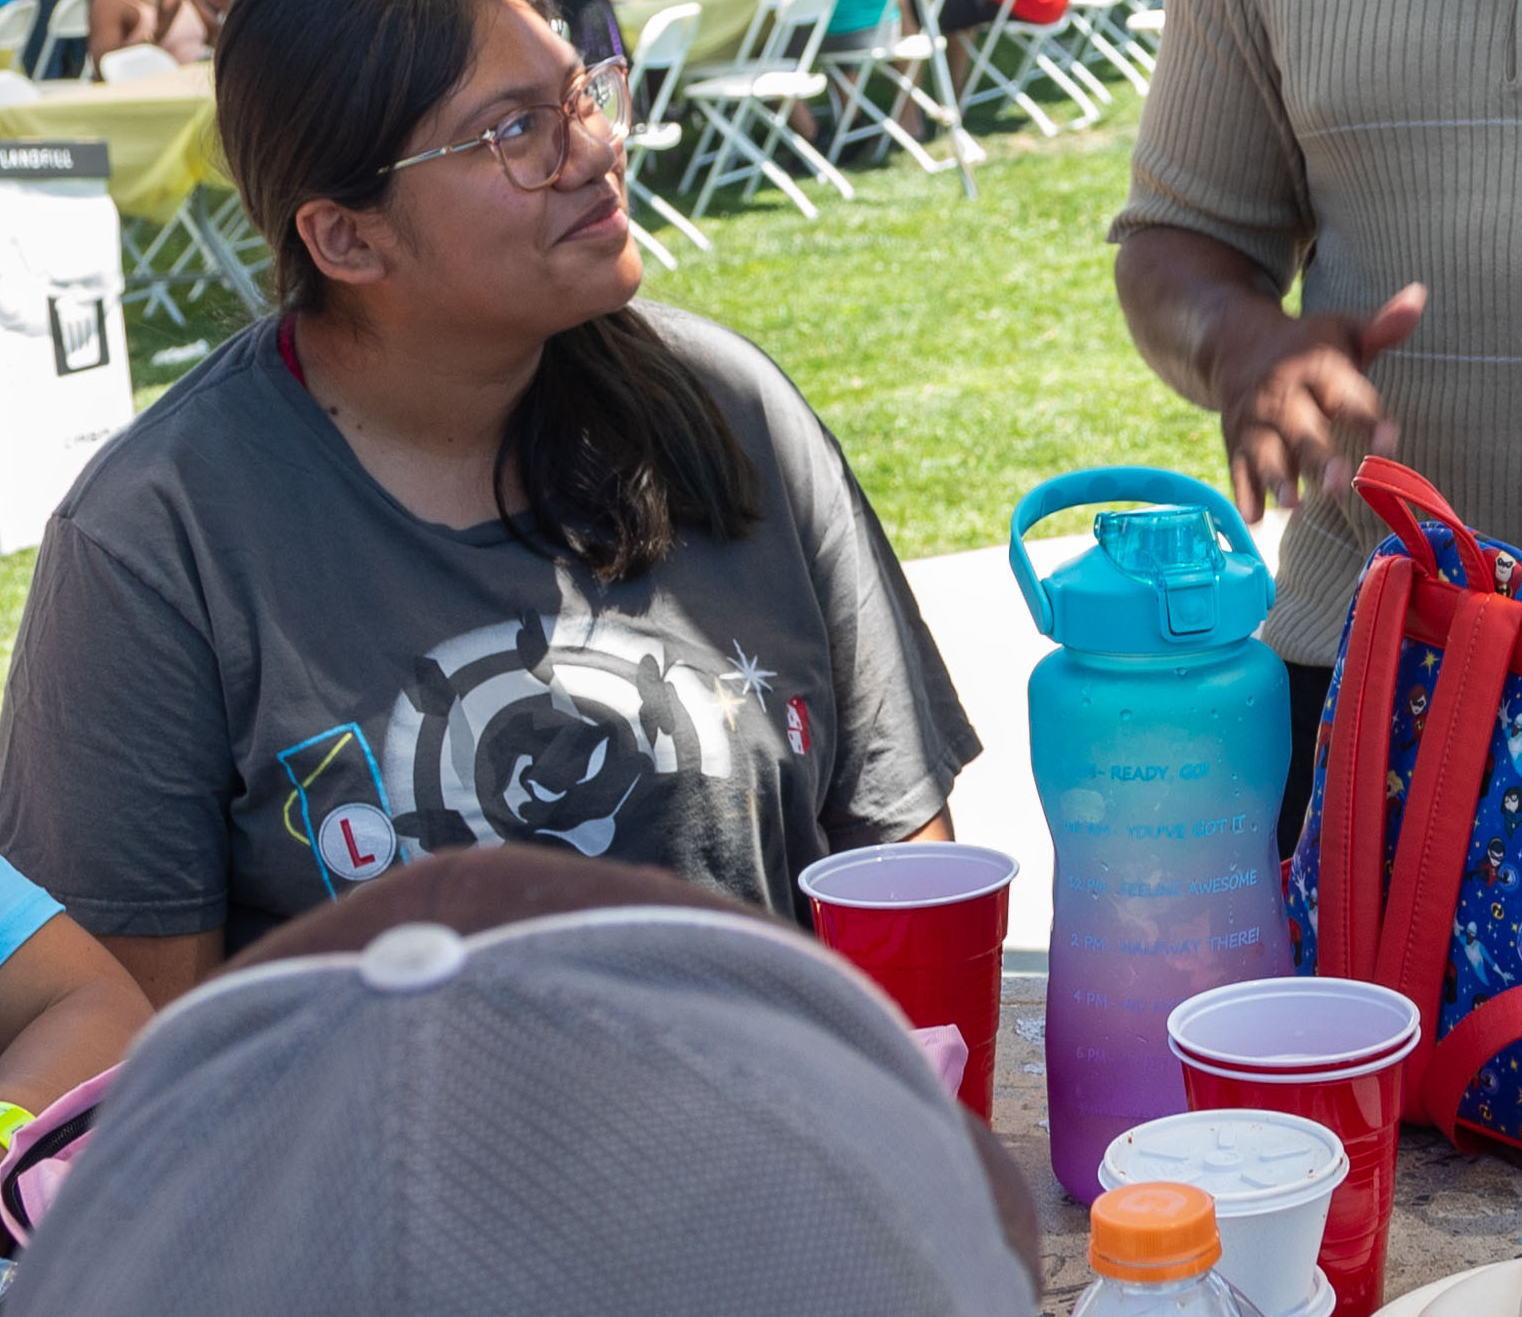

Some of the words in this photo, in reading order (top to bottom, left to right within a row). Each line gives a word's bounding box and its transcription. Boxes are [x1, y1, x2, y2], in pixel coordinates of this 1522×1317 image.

[1192, 818, 1228, 837] GOT
[339, 817, 376, 869] L
[1187, 868, 1258, 895] AWESOME
[1070, 933, 1080, 947] 2
[1208, 926, 1261, 951] THERE!
